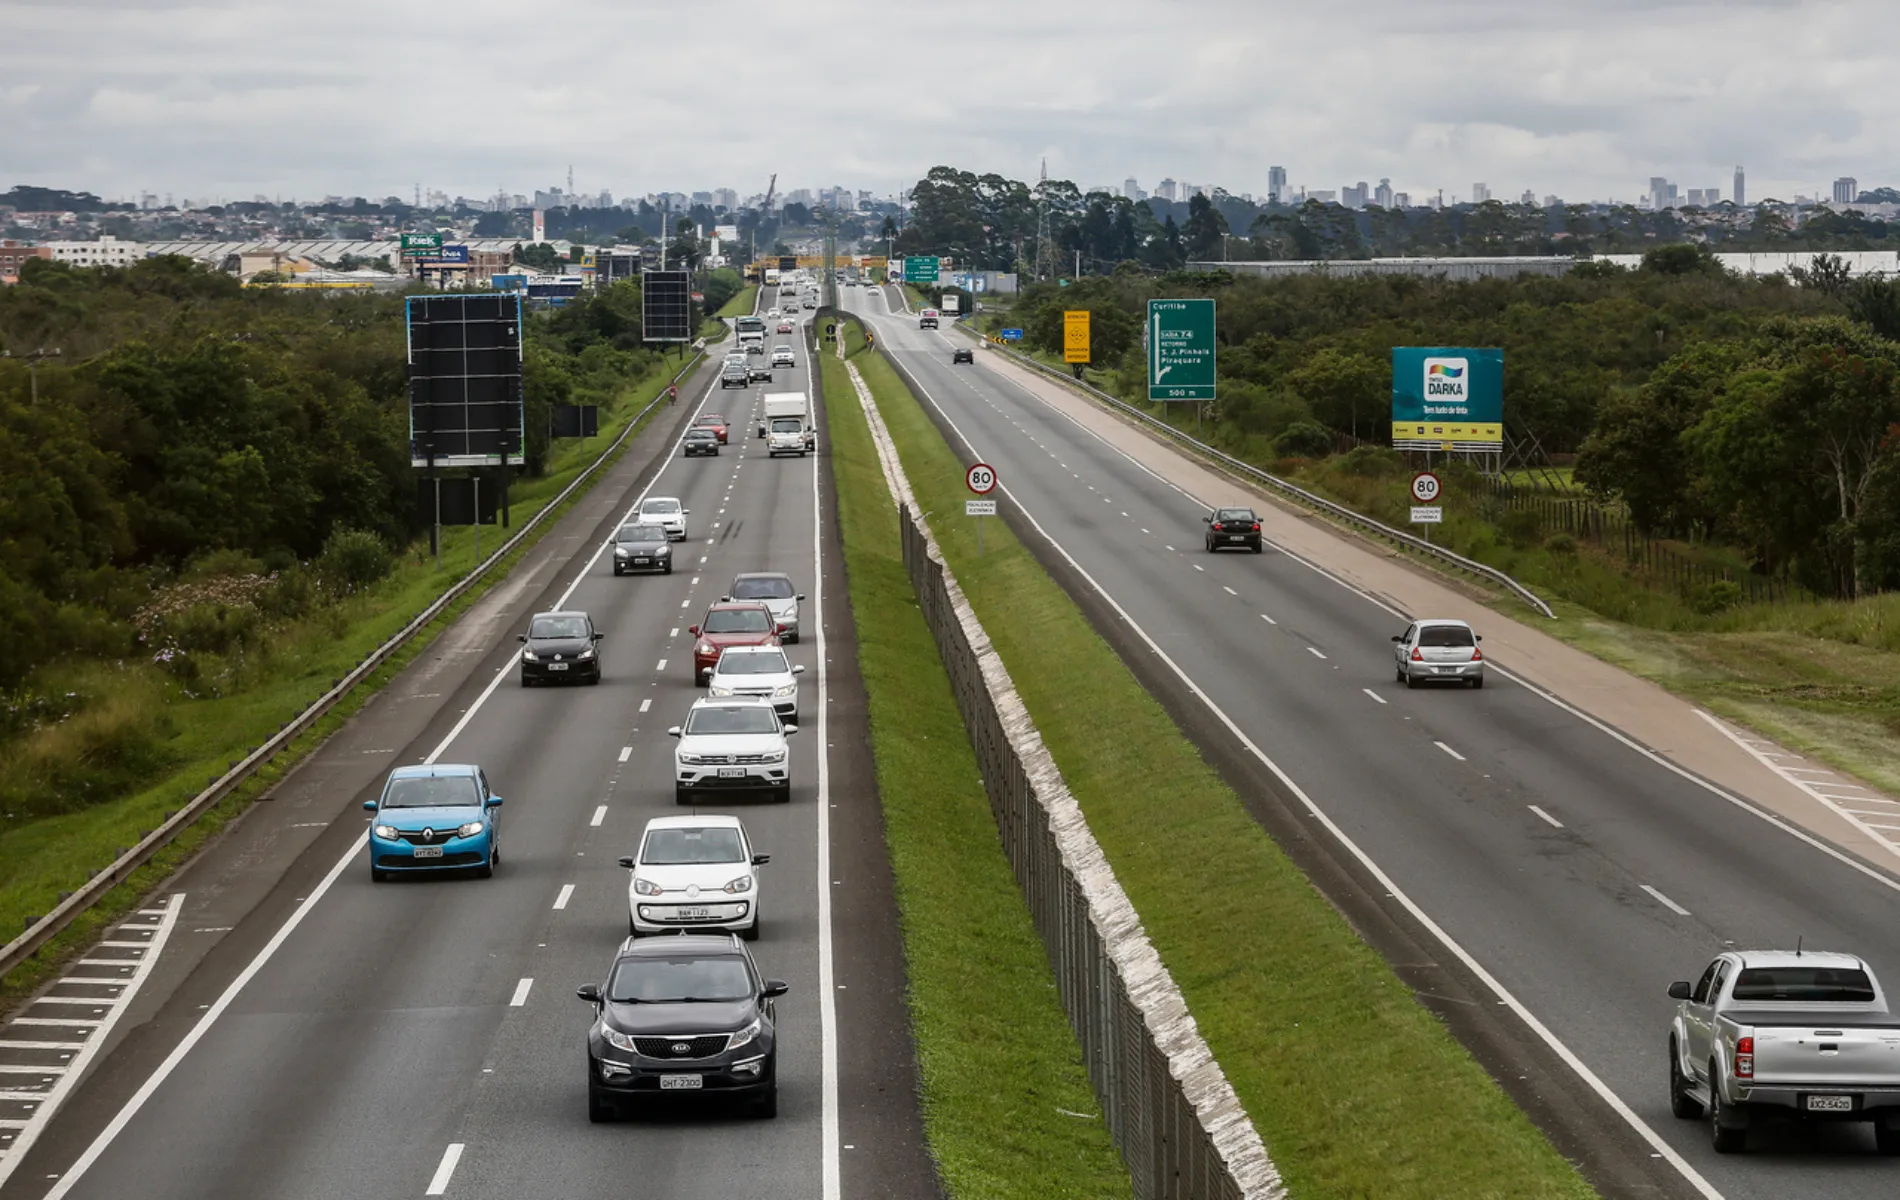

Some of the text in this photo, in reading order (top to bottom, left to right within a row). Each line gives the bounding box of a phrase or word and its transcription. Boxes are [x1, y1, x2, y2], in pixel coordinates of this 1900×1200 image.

[1428, 383, 1463, 395] DARKA
[973, 472, 991, 484] 80
[1417, 480, 1435, 492] 80
